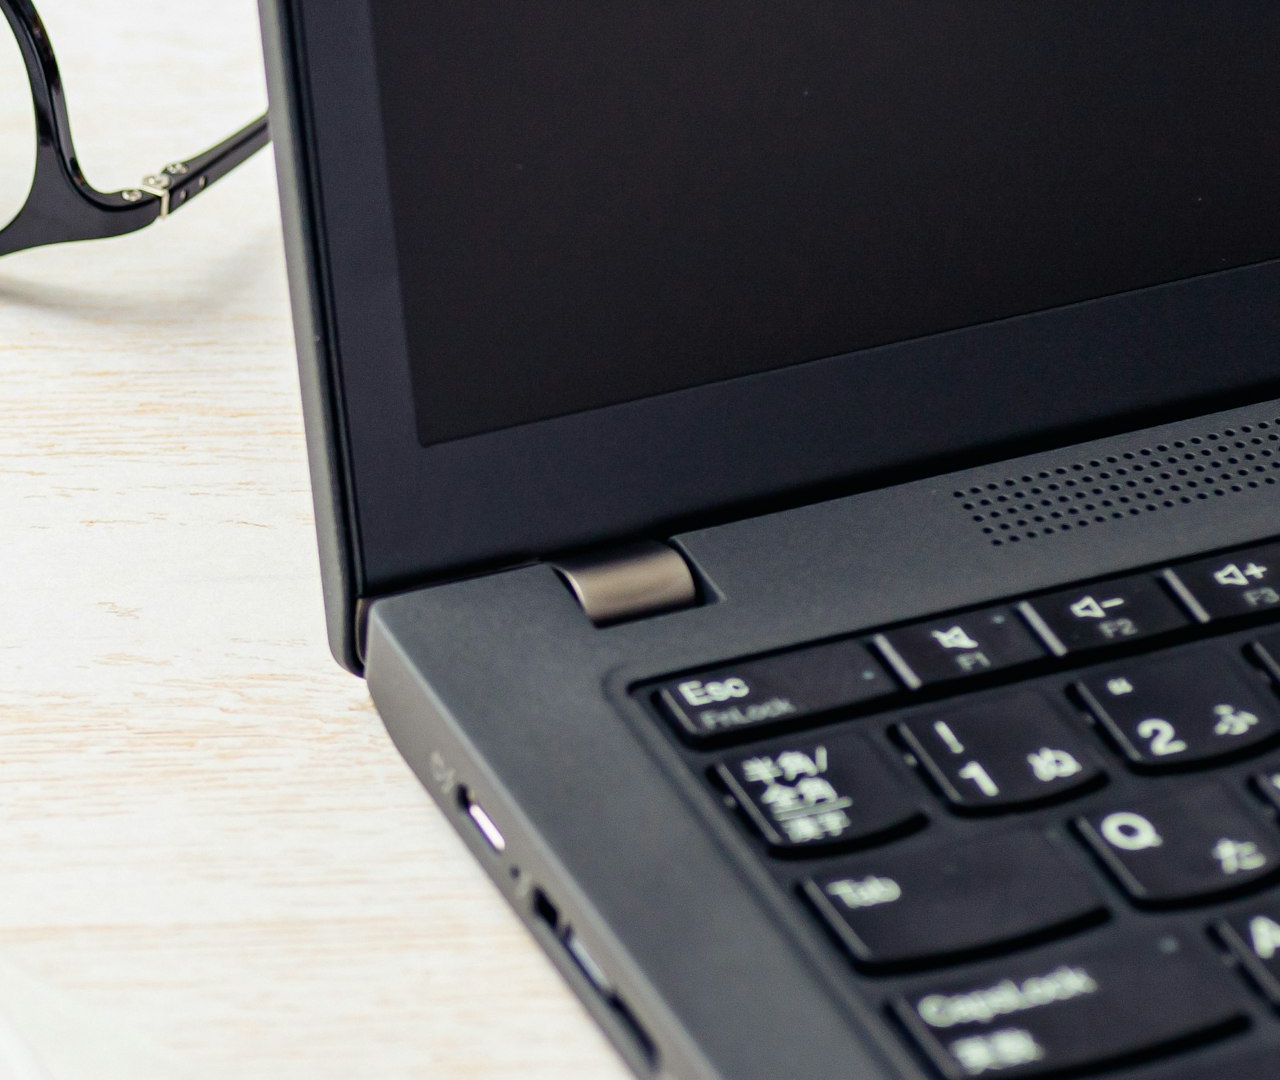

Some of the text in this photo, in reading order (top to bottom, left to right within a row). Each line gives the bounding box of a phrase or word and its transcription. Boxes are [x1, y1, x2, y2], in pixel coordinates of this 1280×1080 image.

[1099, 618, 1138, 639] F2
[956, 652, 989, 671] F1
[678, 677, 750, 706] Esc
[1137, 719, 1188, 756] 2
[959, 761, 1000, 797] 1
[1101, 812, 1164, 850] Q
